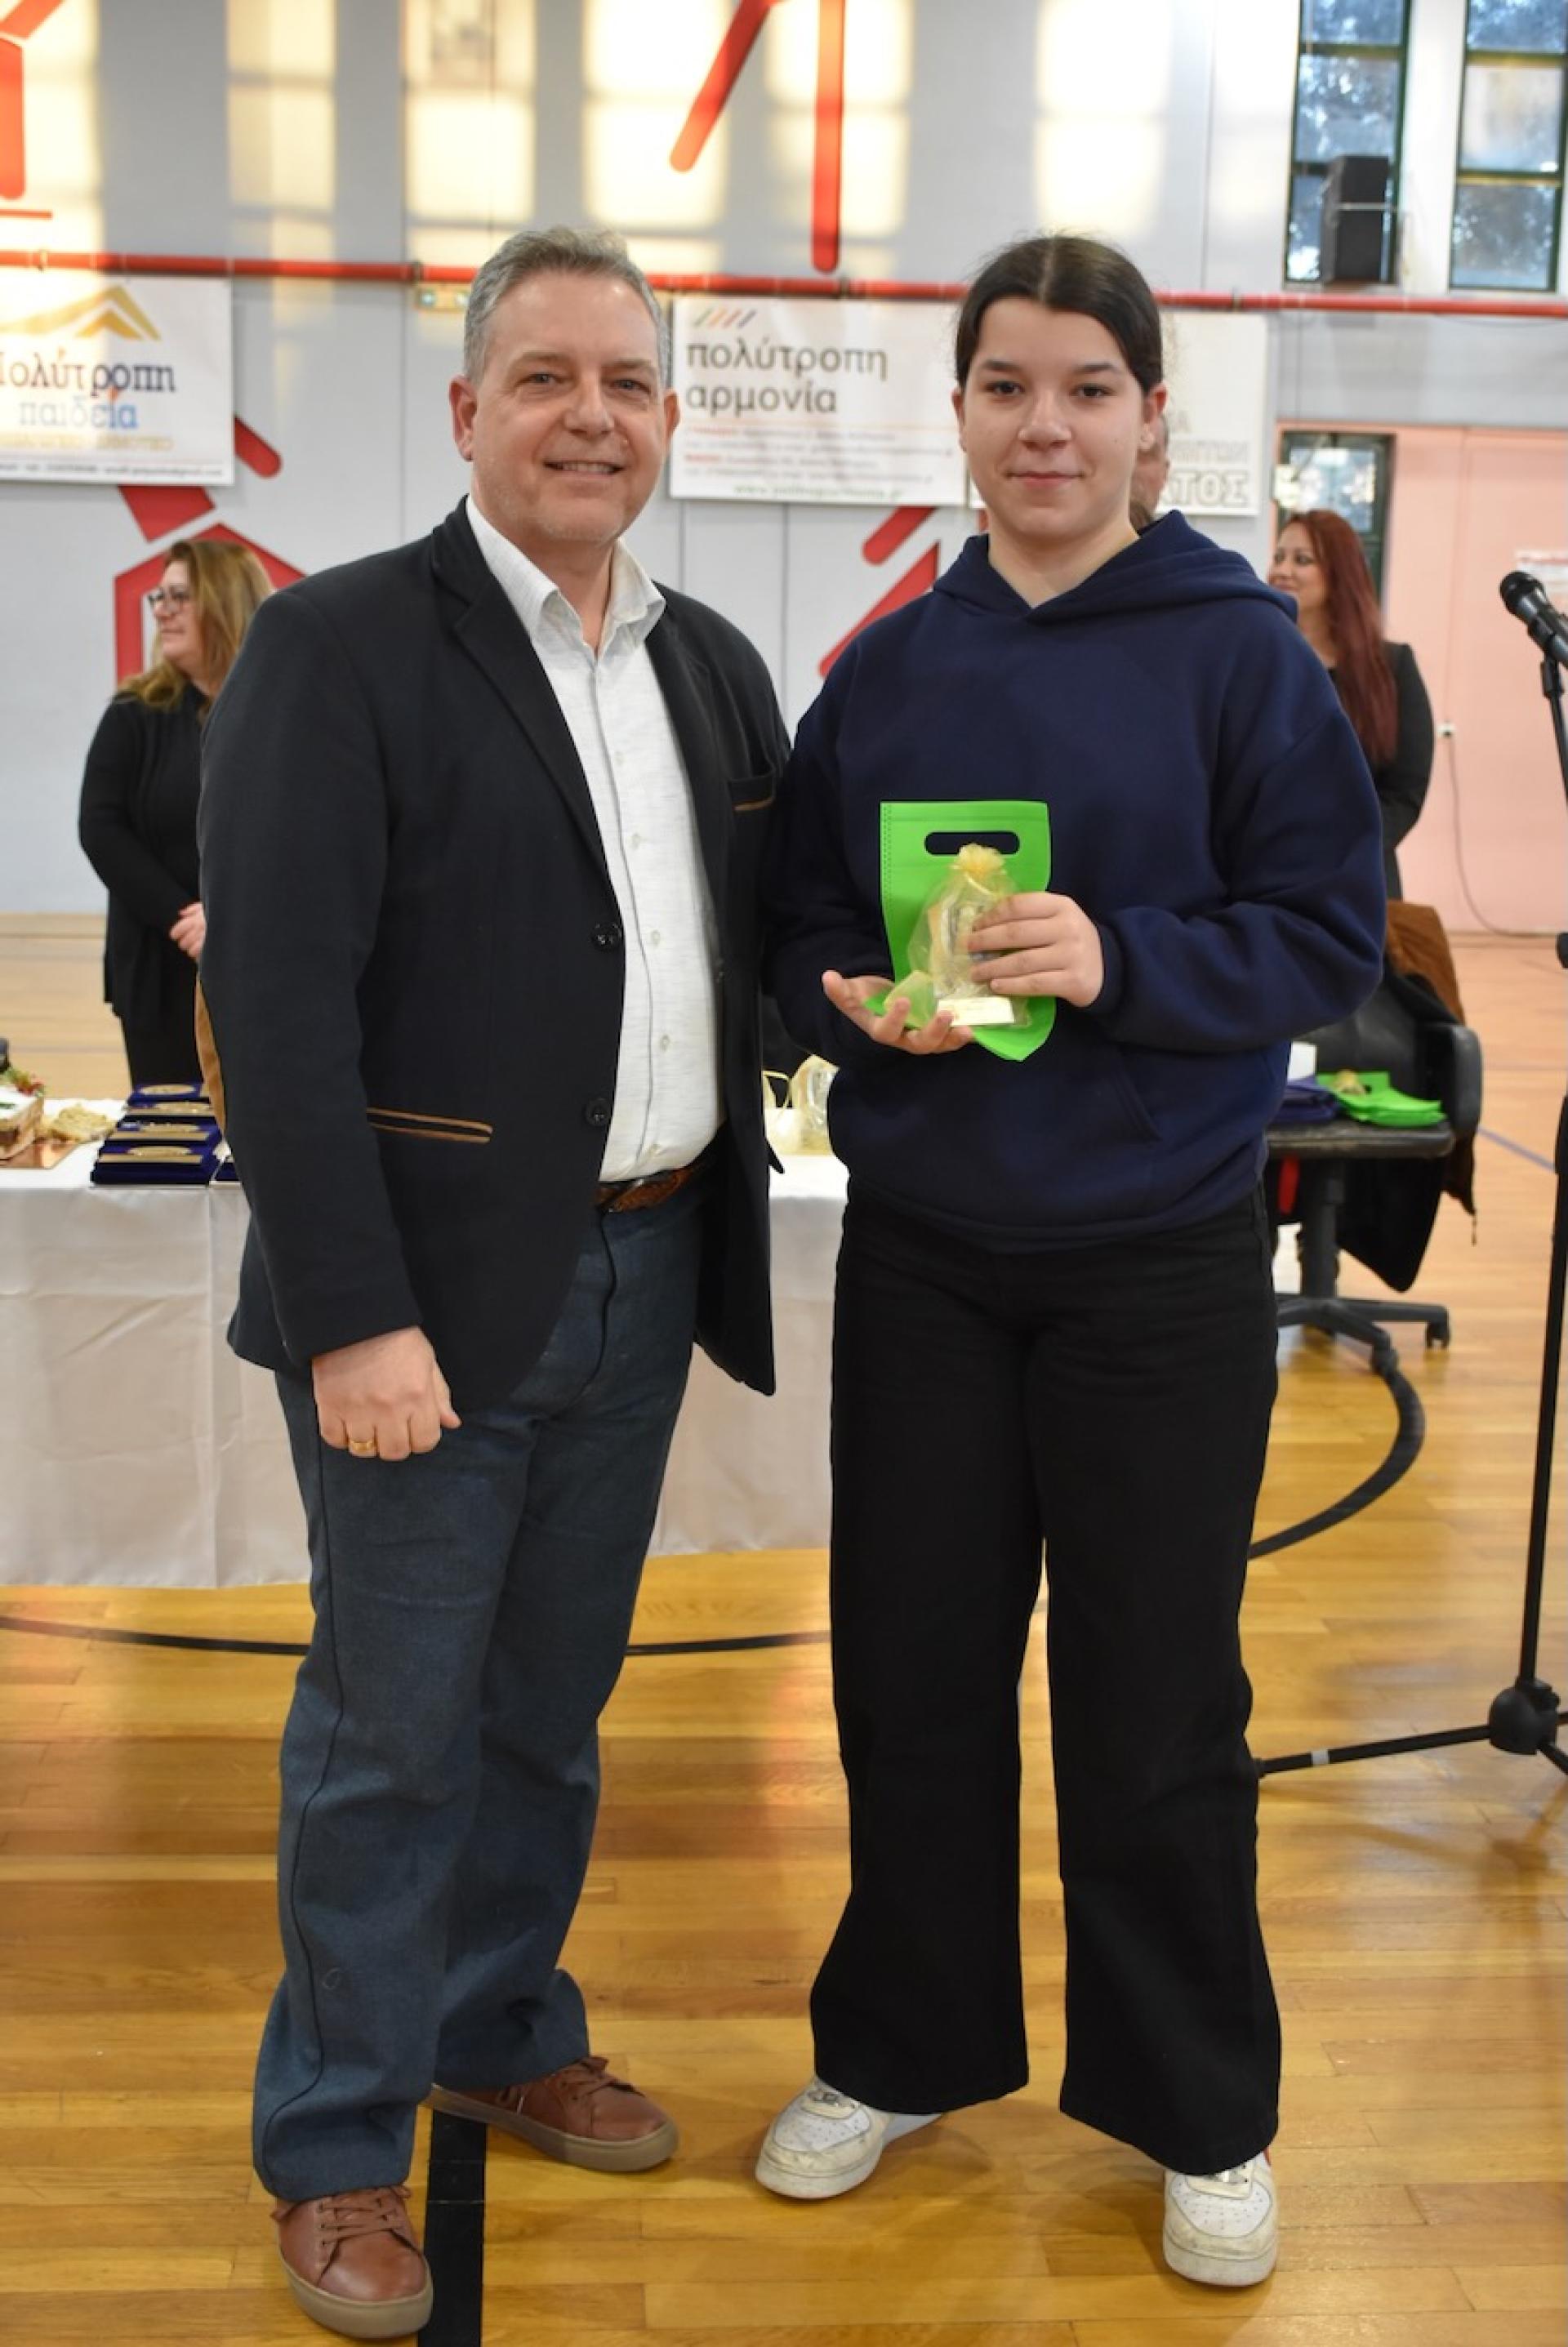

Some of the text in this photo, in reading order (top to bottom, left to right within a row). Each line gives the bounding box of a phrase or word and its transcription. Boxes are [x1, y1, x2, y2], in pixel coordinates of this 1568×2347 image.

[686, 337, 888, 381] πολύτροπη
[20, 388, 139, 430] παιδεία
[685, 381, 837, 417] αρμονία
